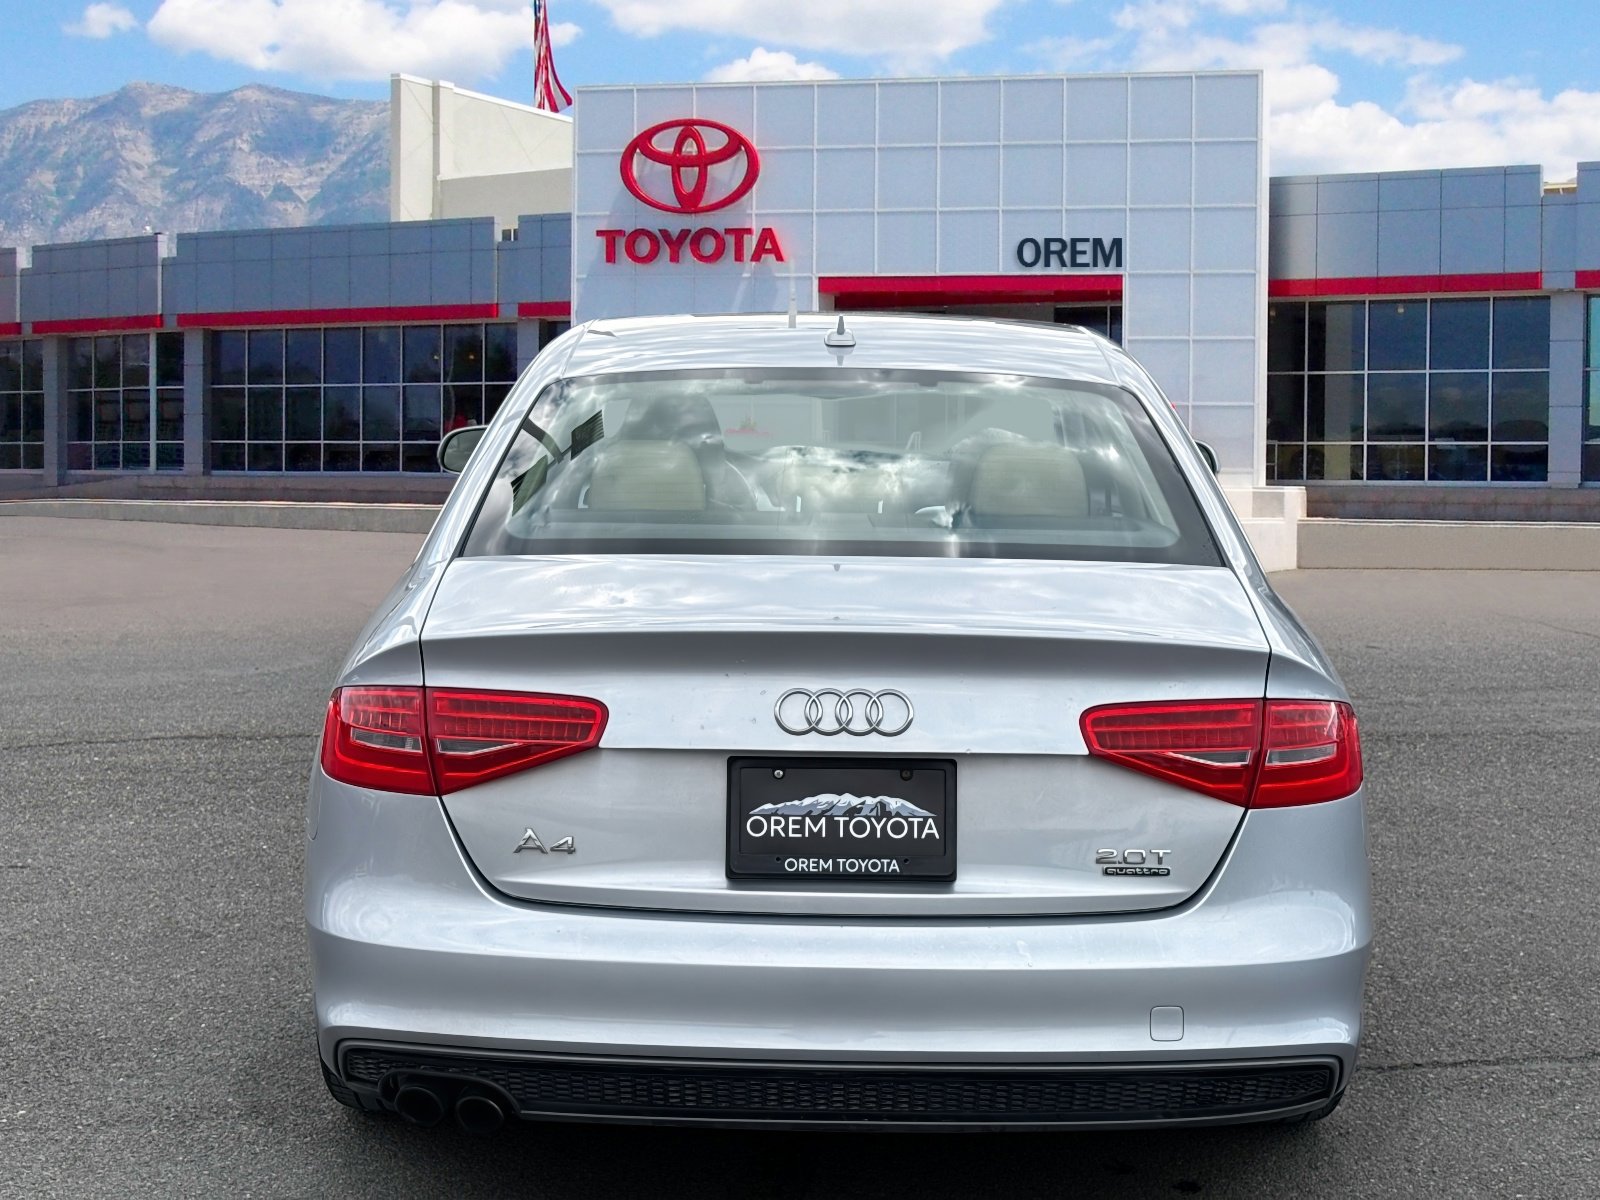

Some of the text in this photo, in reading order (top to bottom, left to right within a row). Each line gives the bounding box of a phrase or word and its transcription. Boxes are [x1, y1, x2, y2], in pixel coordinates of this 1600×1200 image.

[596, 227, 784, 264] TOYOTA
[1017, 237, 1123, 268] OREM
[746, 815, 940, 839] OREM TOYOTA
[513, 828, 576, 855] A4
[784, 857, 900, 873] OREM TOYOTA
[1095, 848, 1172, 865] 2.0T
[1106, 867, 1169, 876] quattro
